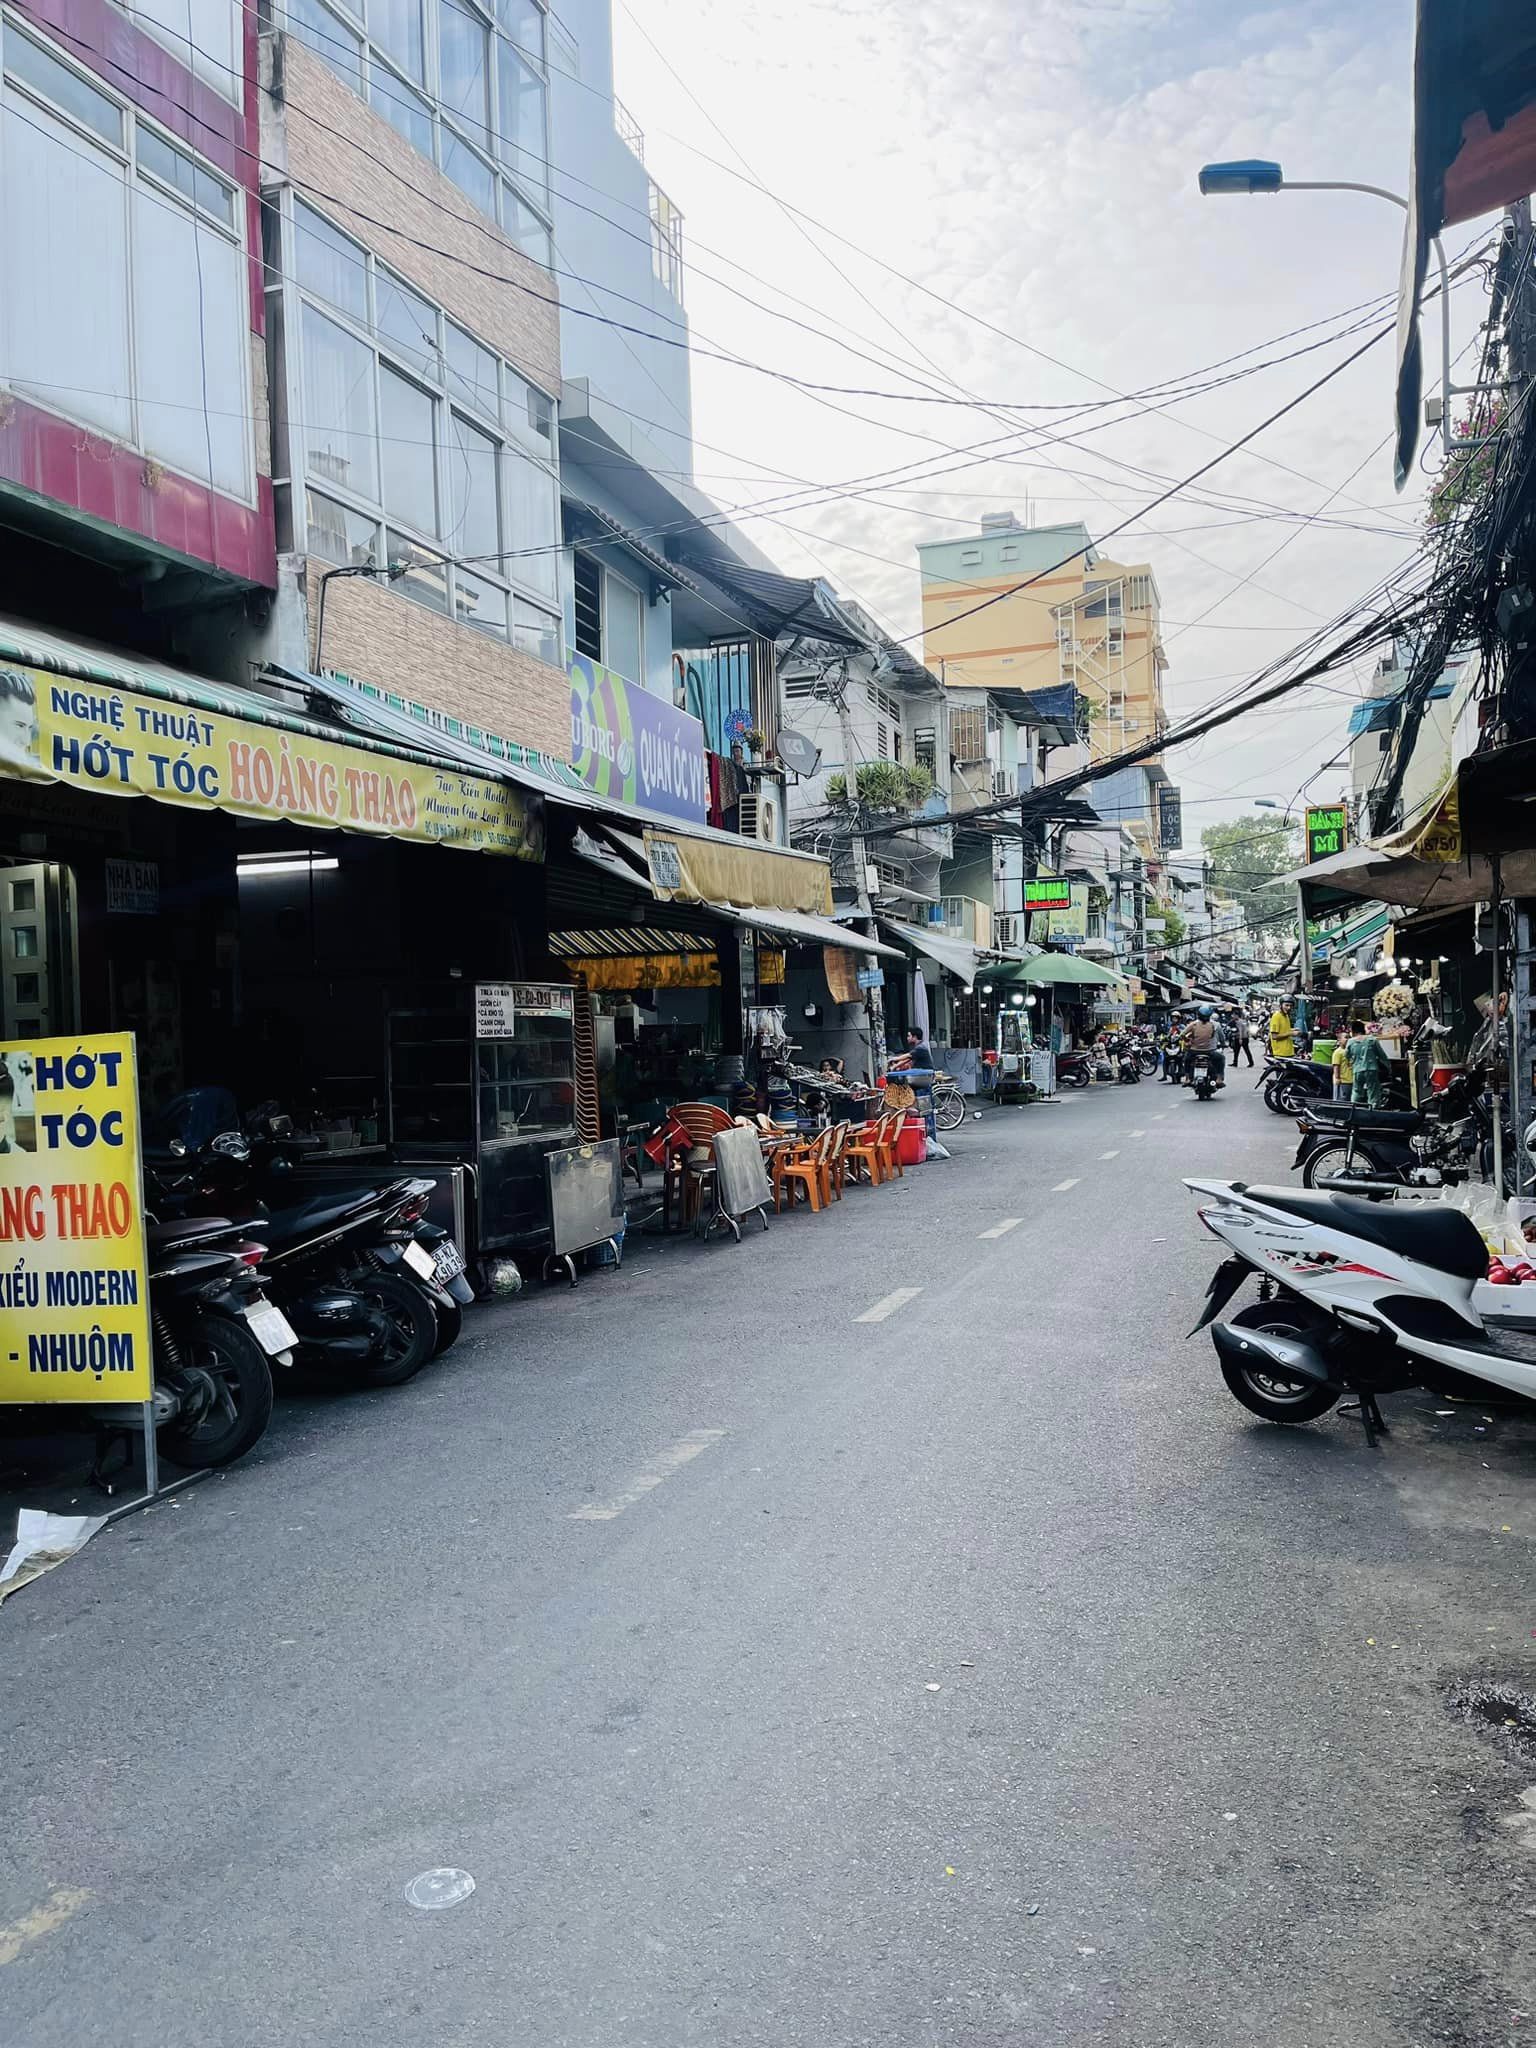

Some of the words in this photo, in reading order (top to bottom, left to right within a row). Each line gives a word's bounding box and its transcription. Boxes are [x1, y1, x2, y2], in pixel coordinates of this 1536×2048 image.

[51, 686, 125, 732] NGHỆ
[134, 706, 214, 748] THUẬT
[52, 733, 134, 783] HỚT
[147, 751, 219, 797] TÓC
[228, 735, 339, 817] HOÀNG
[344, 766, 416, 829] THAO
[435, 774, 454, 795] Tạo
[641, 720, 673, 797] QUÁN
[674, 727, 688, 801] ỐC
[1168, 826, 1175, 837] 2
[35, 1046, 122, 1091] HỚT
[41, 1104, 123, 1149] TÓC
[0, 1184, 45, 1241] NG
[51, 1181, 132, 1241] THAO
[46, 1270, 138, 1307] MODERN
[28, 1325, 134, 1381] NHUỘM
